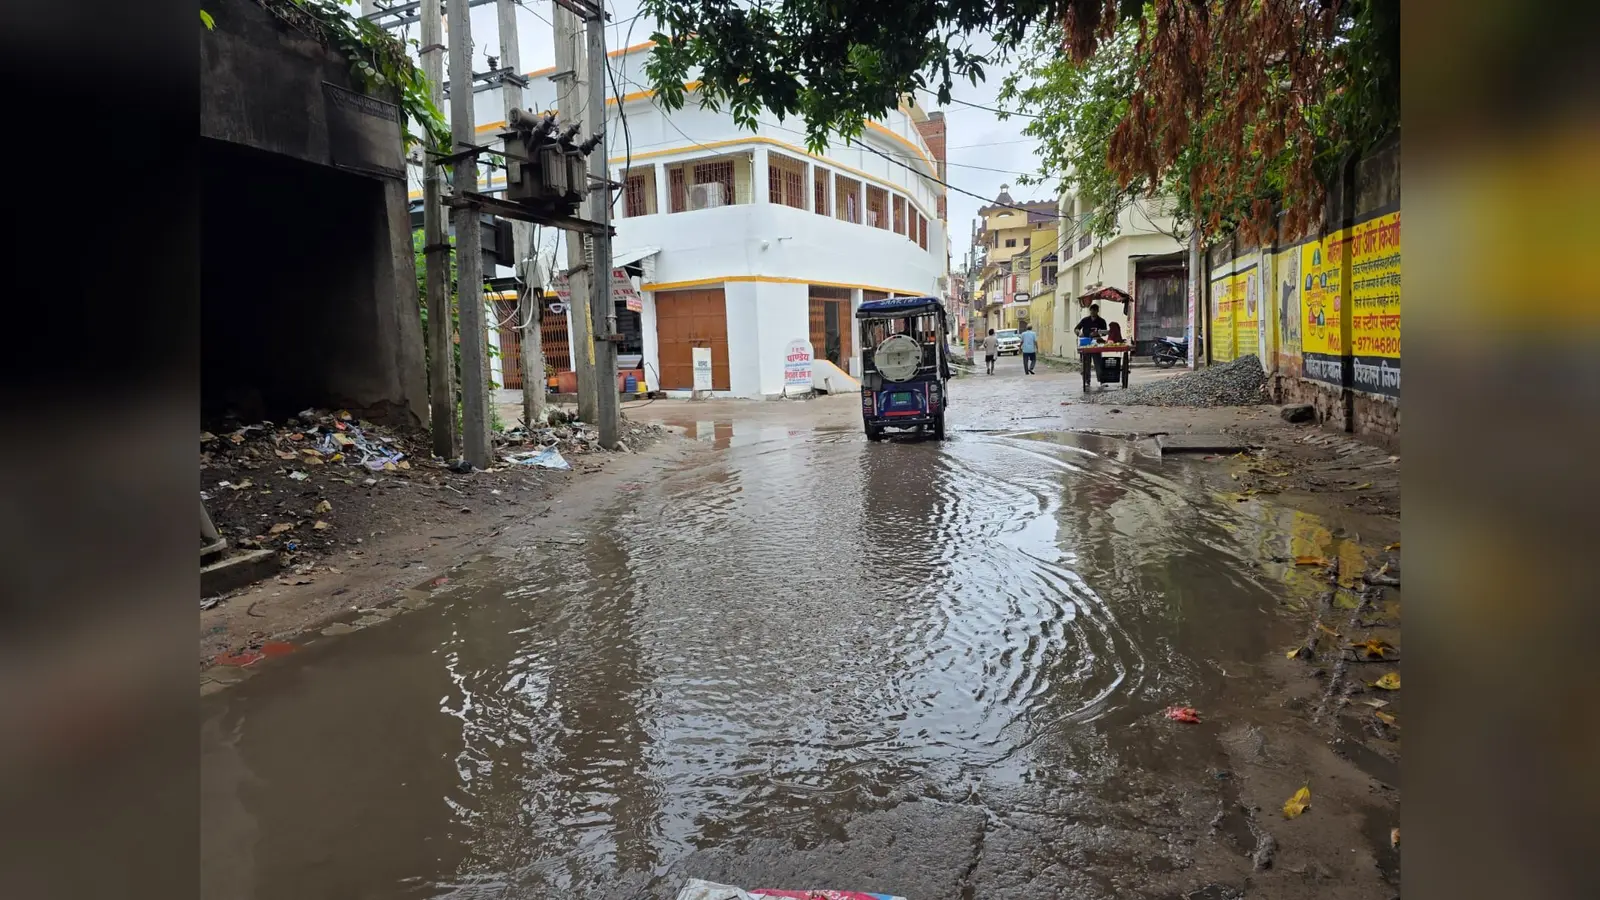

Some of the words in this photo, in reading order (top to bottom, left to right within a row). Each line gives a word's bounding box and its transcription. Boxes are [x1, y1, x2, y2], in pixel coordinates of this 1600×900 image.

[1363, 221, 1377, 253] और
[787, 351, 810, 362] पाण्डेय
[1353, 357, 1379, 390] विकास
[1380, 359, 1400, 389] निग
